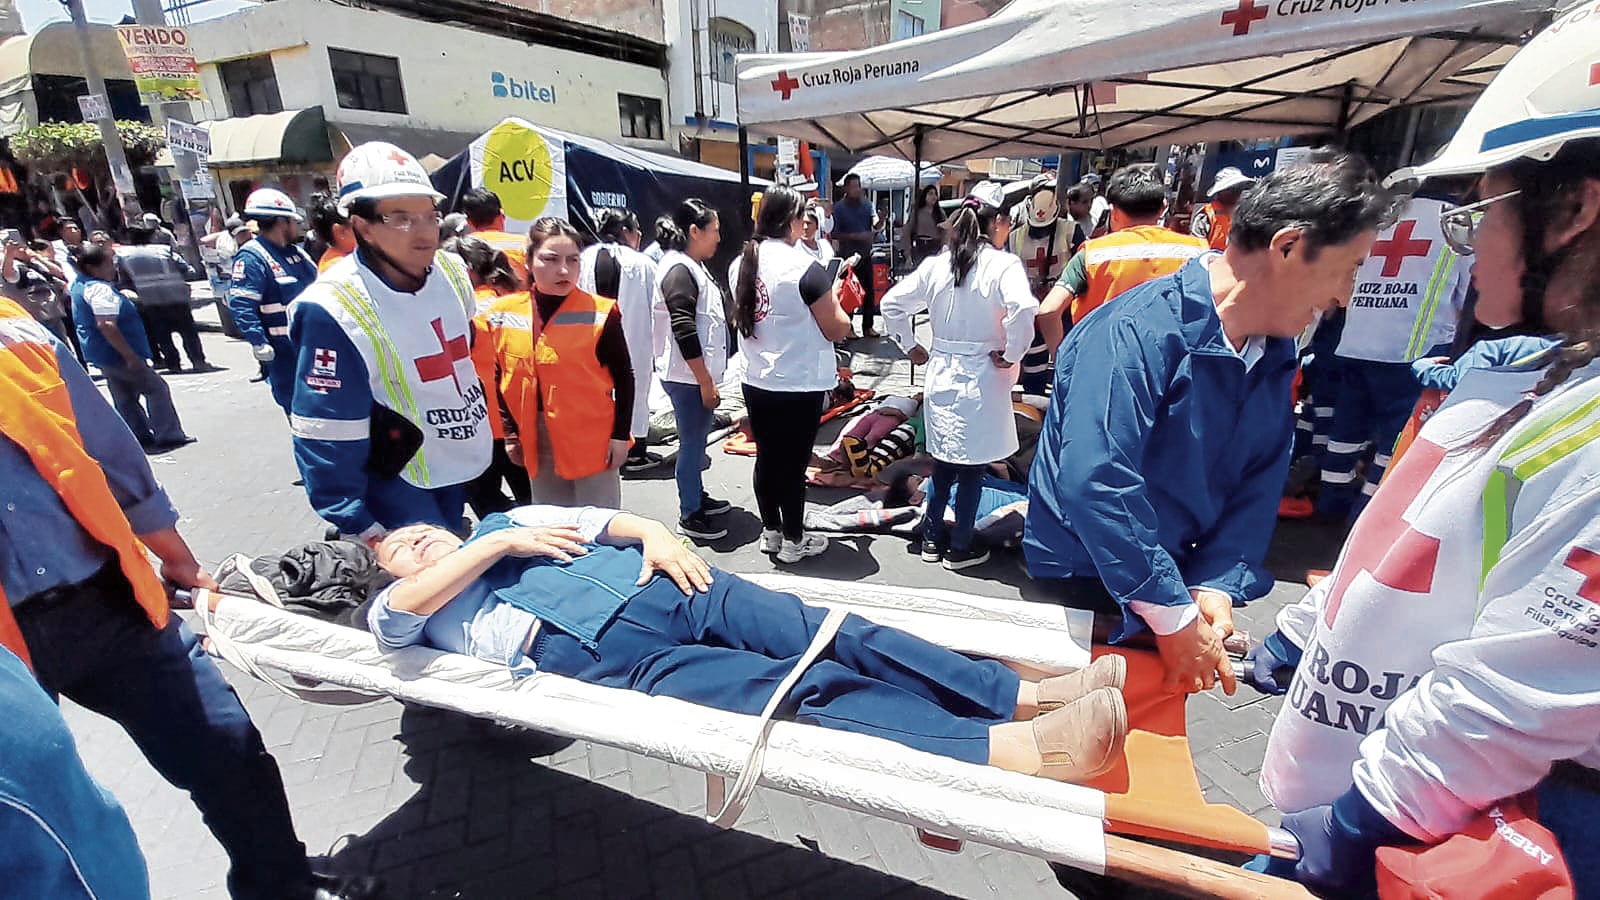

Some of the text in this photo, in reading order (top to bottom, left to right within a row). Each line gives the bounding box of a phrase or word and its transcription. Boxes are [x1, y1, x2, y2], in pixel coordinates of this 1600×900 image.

[1277, 0, 1325, 16] Cruz
[119, 28, 186, 45] VENDO
[802, 60, 919, 87] Cruz Roja Peruana
[510, 78, 556, 104] bitel
[500, 159, 534, 182] ACV
[592, 191, 627, 208] GOBIERNO
[1383, 282, 1418, 294] ROJA
[464, 384, 481, 408] OJA
[1544, 586, 1584, 612] Cruz
[1542, 600, 1598, 635] Peruna
